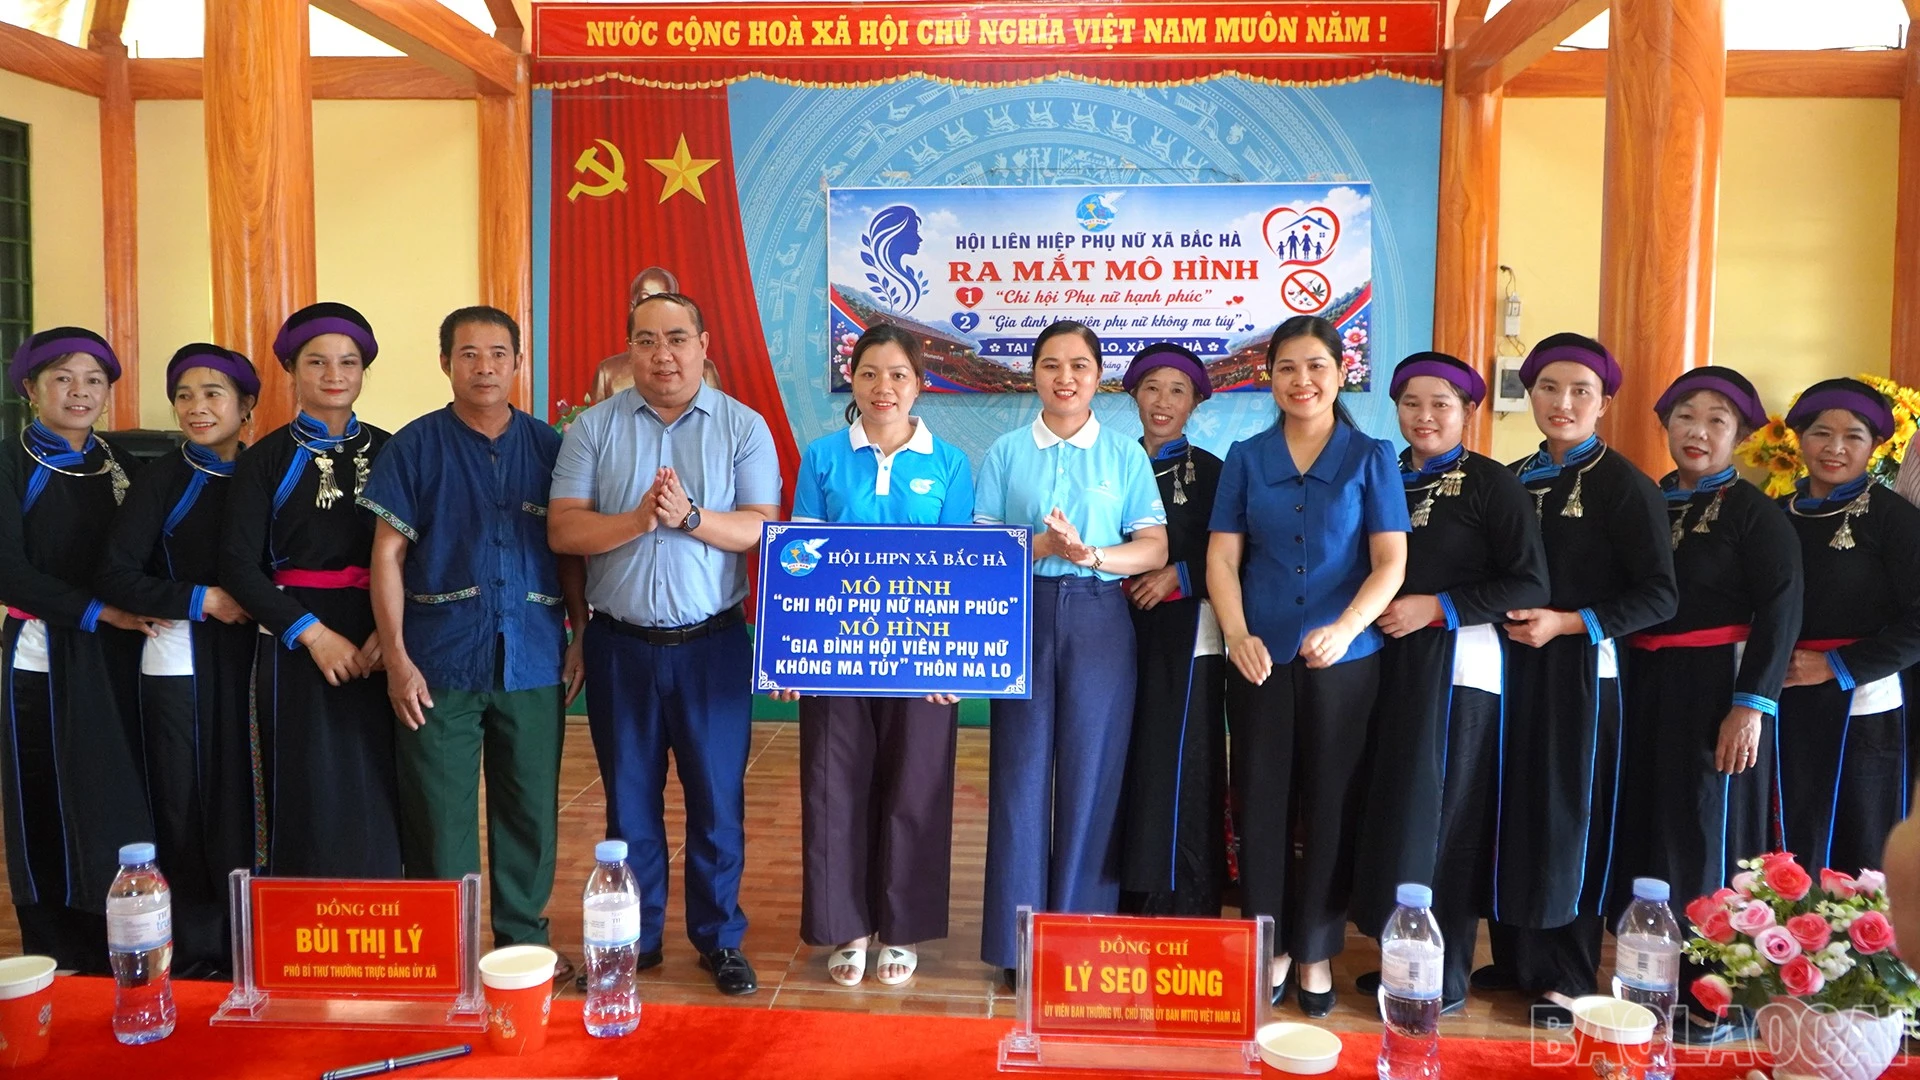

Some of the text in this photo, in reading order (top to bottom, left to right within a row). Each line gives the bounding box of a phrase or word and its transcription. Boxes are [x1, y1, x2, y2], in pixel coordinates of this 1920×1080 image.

[587, 16, 658, 46] NƯỚC
[666, 15, 740, 52] CỘNG
[749, 15, 804, 46] HOÀ
[812, 15, 851, 46] XÃ
[859, 14, 908, 51] HỘI
[918, 12, 971, 45] CHỦ
[979, 13, 1066, 44] NGHĨA
[1073, 13, 1136, 50] VIỆT
[1144, 18, 1206, 44] NAM
[1215, 11, 1299, 43] MUÔN
[1305, 10, 1370, 42] NĂM
[956, 229, 1241, 252] HỘI LIÊN HIỆP PHỤ NỮ XÃ BẮC HÀ
[949, 254, 1259, 282] RA MẮT MÔ HÌNH
[965, 290, 975, 304] 1
[1035, 290, 1059, 307] hội
[1065, 289, 1096, 306] Phụ
[1100, 290, 1121, 303] nữ
[1124, 289, 1162, 306] hạnh
[960, 317, 971, 329] 2
[1021, 315, 1048, 328] đình
[1103, 314, 1127, 331] phụ
[1131, 315, 1149, 327] nữ
[1151, 314, 1187, 330] không
[1192, 318, 1211, 327] ma
[1006, 342, 1027, 355] TẠI
[1127, 340, 1145, 352] XÃ
[1183, 340, 1202, 352] HÀ
[1102, 361, 1121, 371] háng
[828, 548, 1007, 567] HỘI LHPN XÃ BẮC HÀ
[840, 576, 951, 596] MÔ HÌNH
[773, 593, 1018, 617] “CHI HỘI PHỤ NỮ HẠNH PHÚC”
[839, 617, 950, 637] MÔ HÌNH
[782, 635, 1008, 659] “GIA ĐÌNH HỘI VIÊN PHỤ NỮ
[775, 657, 1011, 678] KHÔNG MA TÚY” THÔN NA LO
[316, 898, 400, 917] ĐỒNG CHÍ
[296, 923, 422, 959] BÙI THỊ LÝ
[1100, 934, 1188, 956] ĐỒNG CHÍ
[283, 963, 300, 977] PHÓ
[302, 963, 311, 977] BÍ
[313, 965, 329, 977] THƯ
[330, 963, 363, 978] THƯỜNG
[365, 964, 386, 980] TRỰC
[412, 962, 423, 978] ỦY
[1065, 961, 1223, 997] LÝ SEO SÙNG
